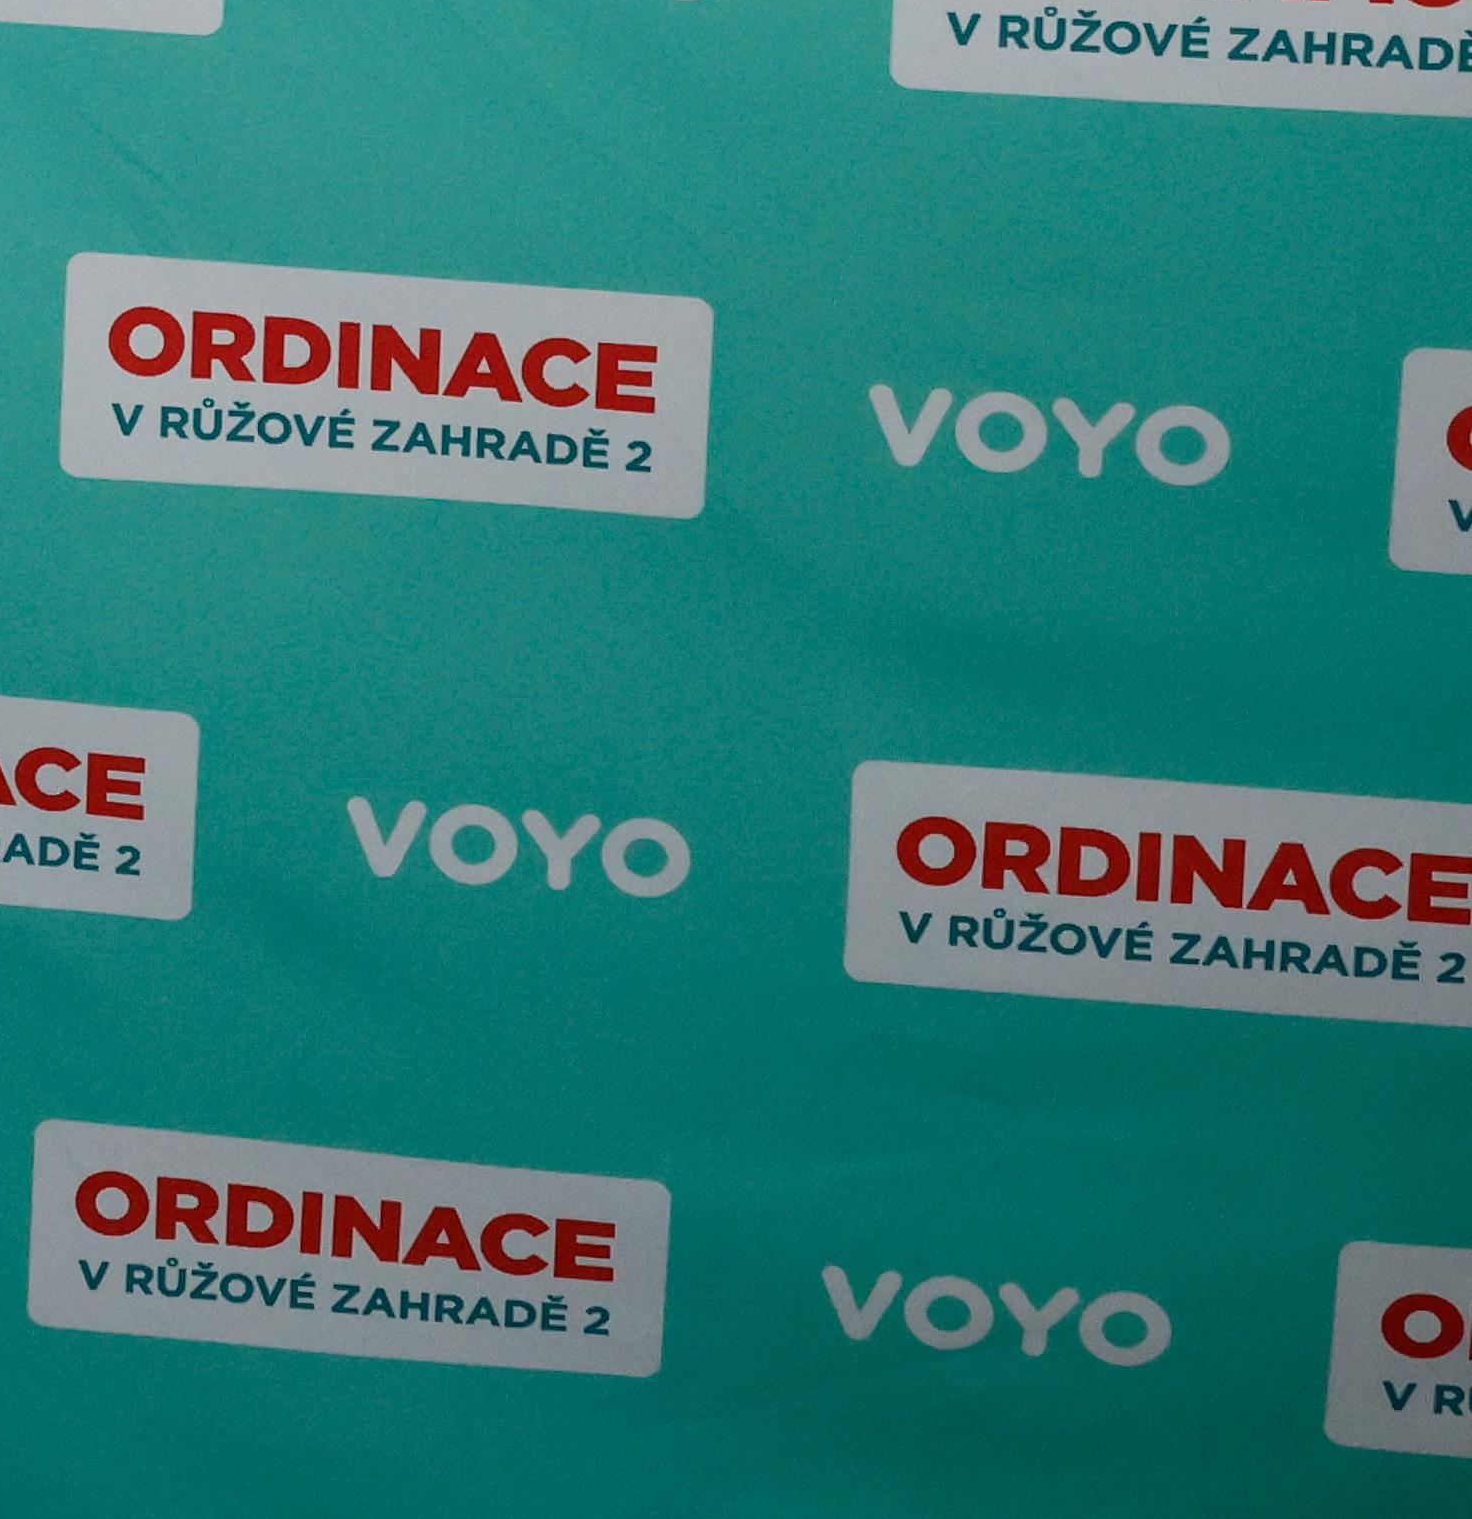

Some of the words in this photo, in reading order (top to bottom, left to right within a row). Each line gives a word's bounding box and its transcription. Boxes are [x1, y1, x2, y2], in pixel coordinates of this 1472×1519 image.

[110, 307, 657, 413] ORDINACE
[111, 401, 145, 437] V
[159, 395, 356, 450] RŮŽOVÉ
[370, 417, 611, 470] ZAHRADĚ
[624, 438, 653, 474] 2
[869, 383, 1231, 486] VOYO
[114, 843, 142, 877] 2
[347, 797, 691, 897] VOYO
[898, 817, 1472, 925] ORDINACE
[898, 909, 934, 945] V
[947, 905, 1155, 963] RŮŽOVÉ
[1168, 930, 1423, 982] ZAHRADĚ
[1435, 950, 1467, 986] 2
[76, 1171, 615, 1281] ORDINACE
[77, 1257, 110, 1292] V
[124, 1255, 317, 1312] RŮŽOVÉ
[330, 1281, 569, 1333] ZAHRADĚ
[582, 1303, 611, 1337] 2
[822, 1265, 1171, 1367] VOYO
